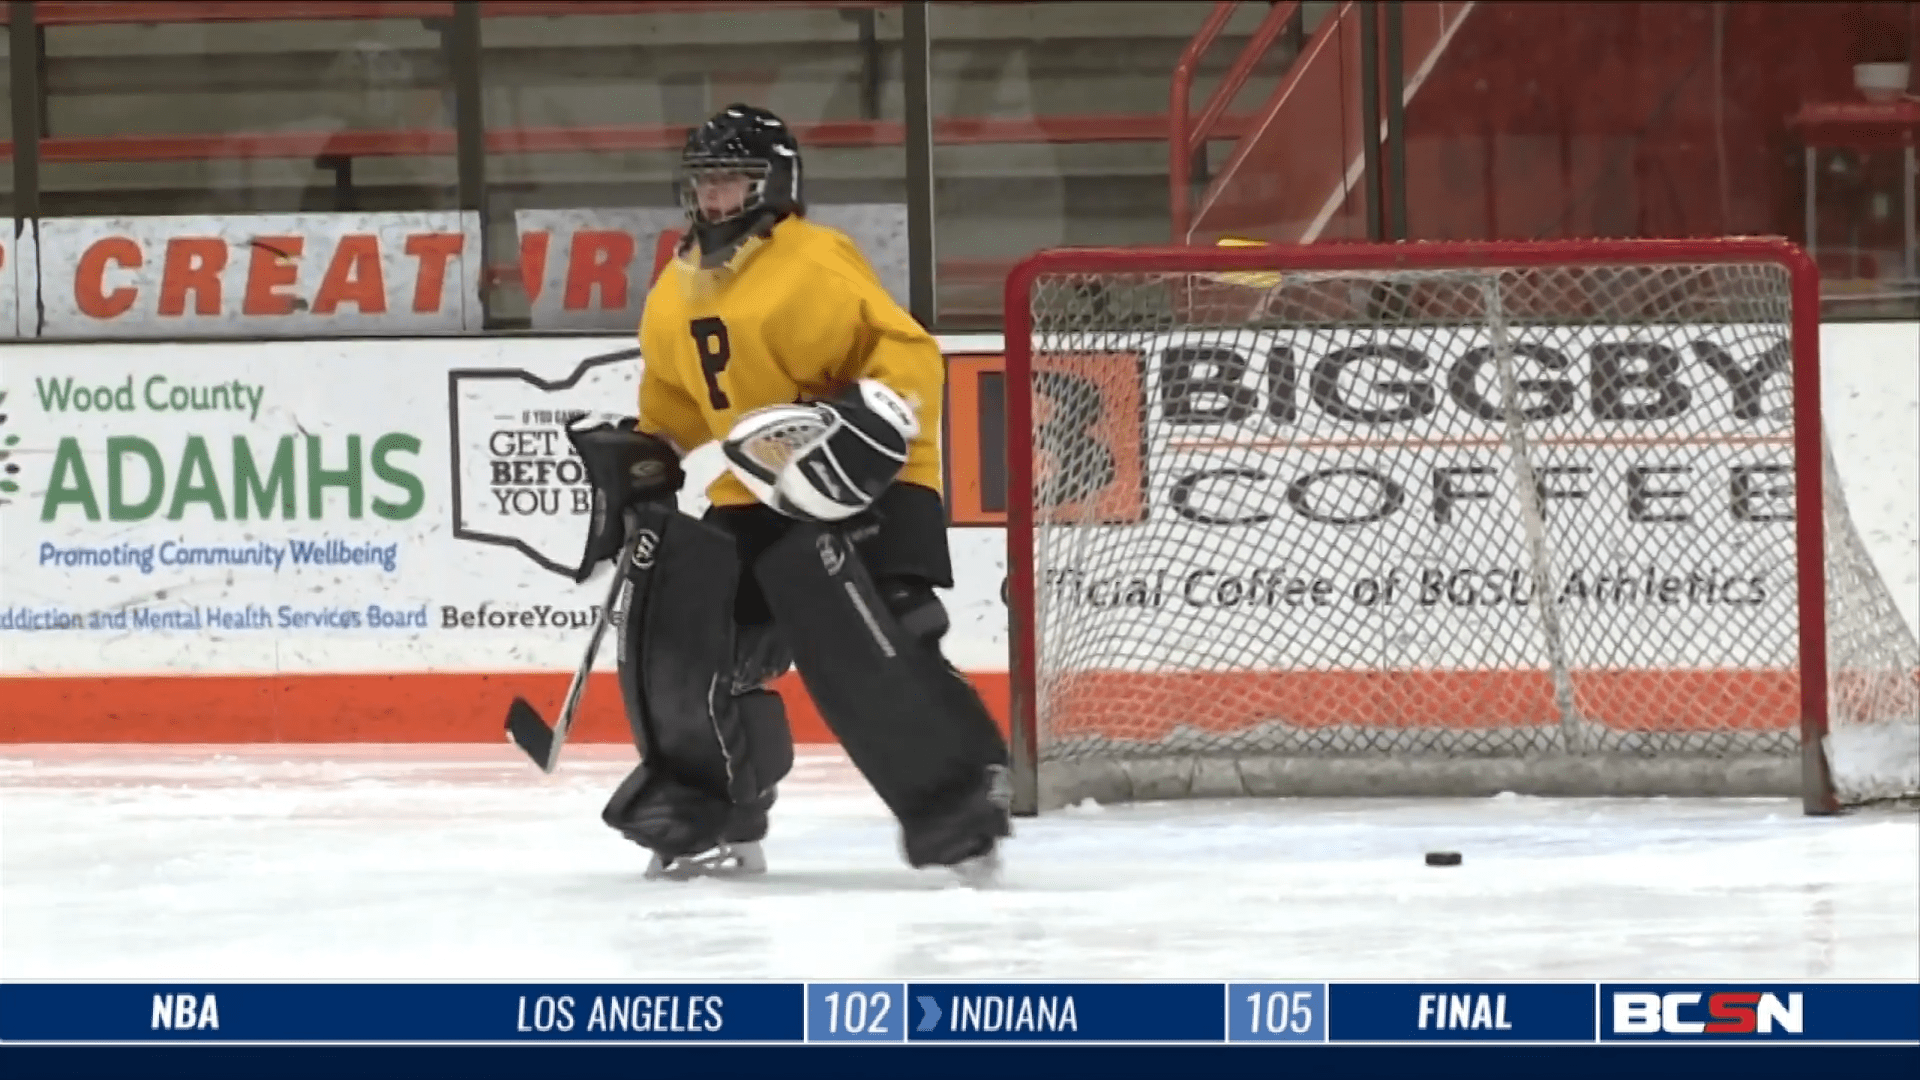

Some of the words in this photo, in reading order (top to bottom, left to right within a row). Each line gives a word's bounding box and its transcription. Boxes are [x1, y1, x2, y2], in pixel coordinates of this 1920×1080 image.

[690, 317, 731, 411] P
[1159, 339, 1791, 425] BIGGBY
[36, 374, 135, 412] Wood
[144, 374, 264, 422] County
[490, 430, 559, 457] GET
[40, 432, 426, 522] ADAMHS
[1169, 467, 1794, 525] COFFEE
[491, 488, 561, 515] YOU
[39, 541, 154, 574] Promoting
[159, 540, 285, 570] Community
[289, 539, 397, 572] Wellbeing
[1184, 567, 1333, 607] Coffee
[1353, 567, 1403, 607] of
[1557, 567, 1768, 606] Athletics
[88, 607, 127, 629] and
[133, 606, 200, 629] Mental
[206, 606, 273, 629] Health
[278, 606, 362, 629] Services
[367, 605, 428, 629] Board
